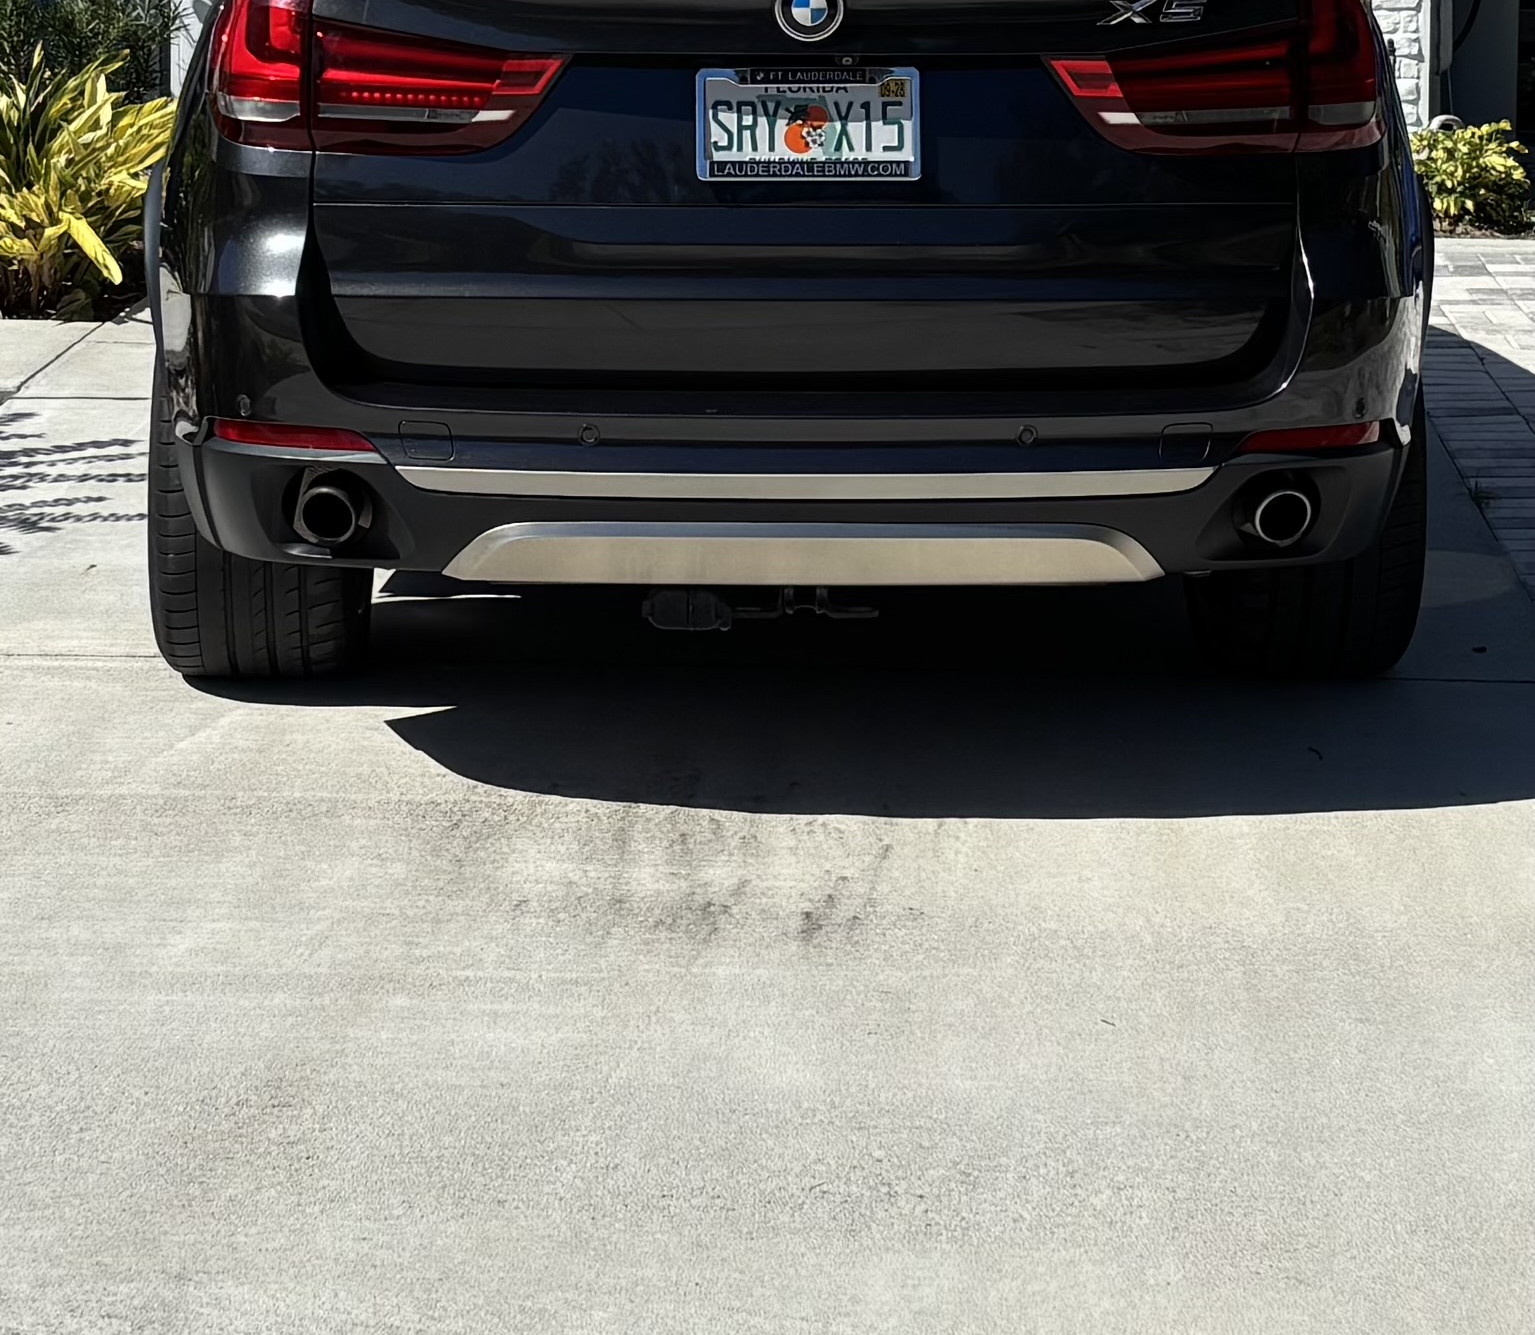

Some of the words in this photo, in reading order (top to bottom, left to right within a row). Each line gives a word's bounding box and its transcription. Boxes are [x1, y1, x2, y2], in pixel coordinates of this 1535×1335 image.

[788, 71, 863, 81] LAUDERDALE
[833, 100, 904, 152] X15
[713, 163, 905, 176] LAUDERDALEBMW.COM
